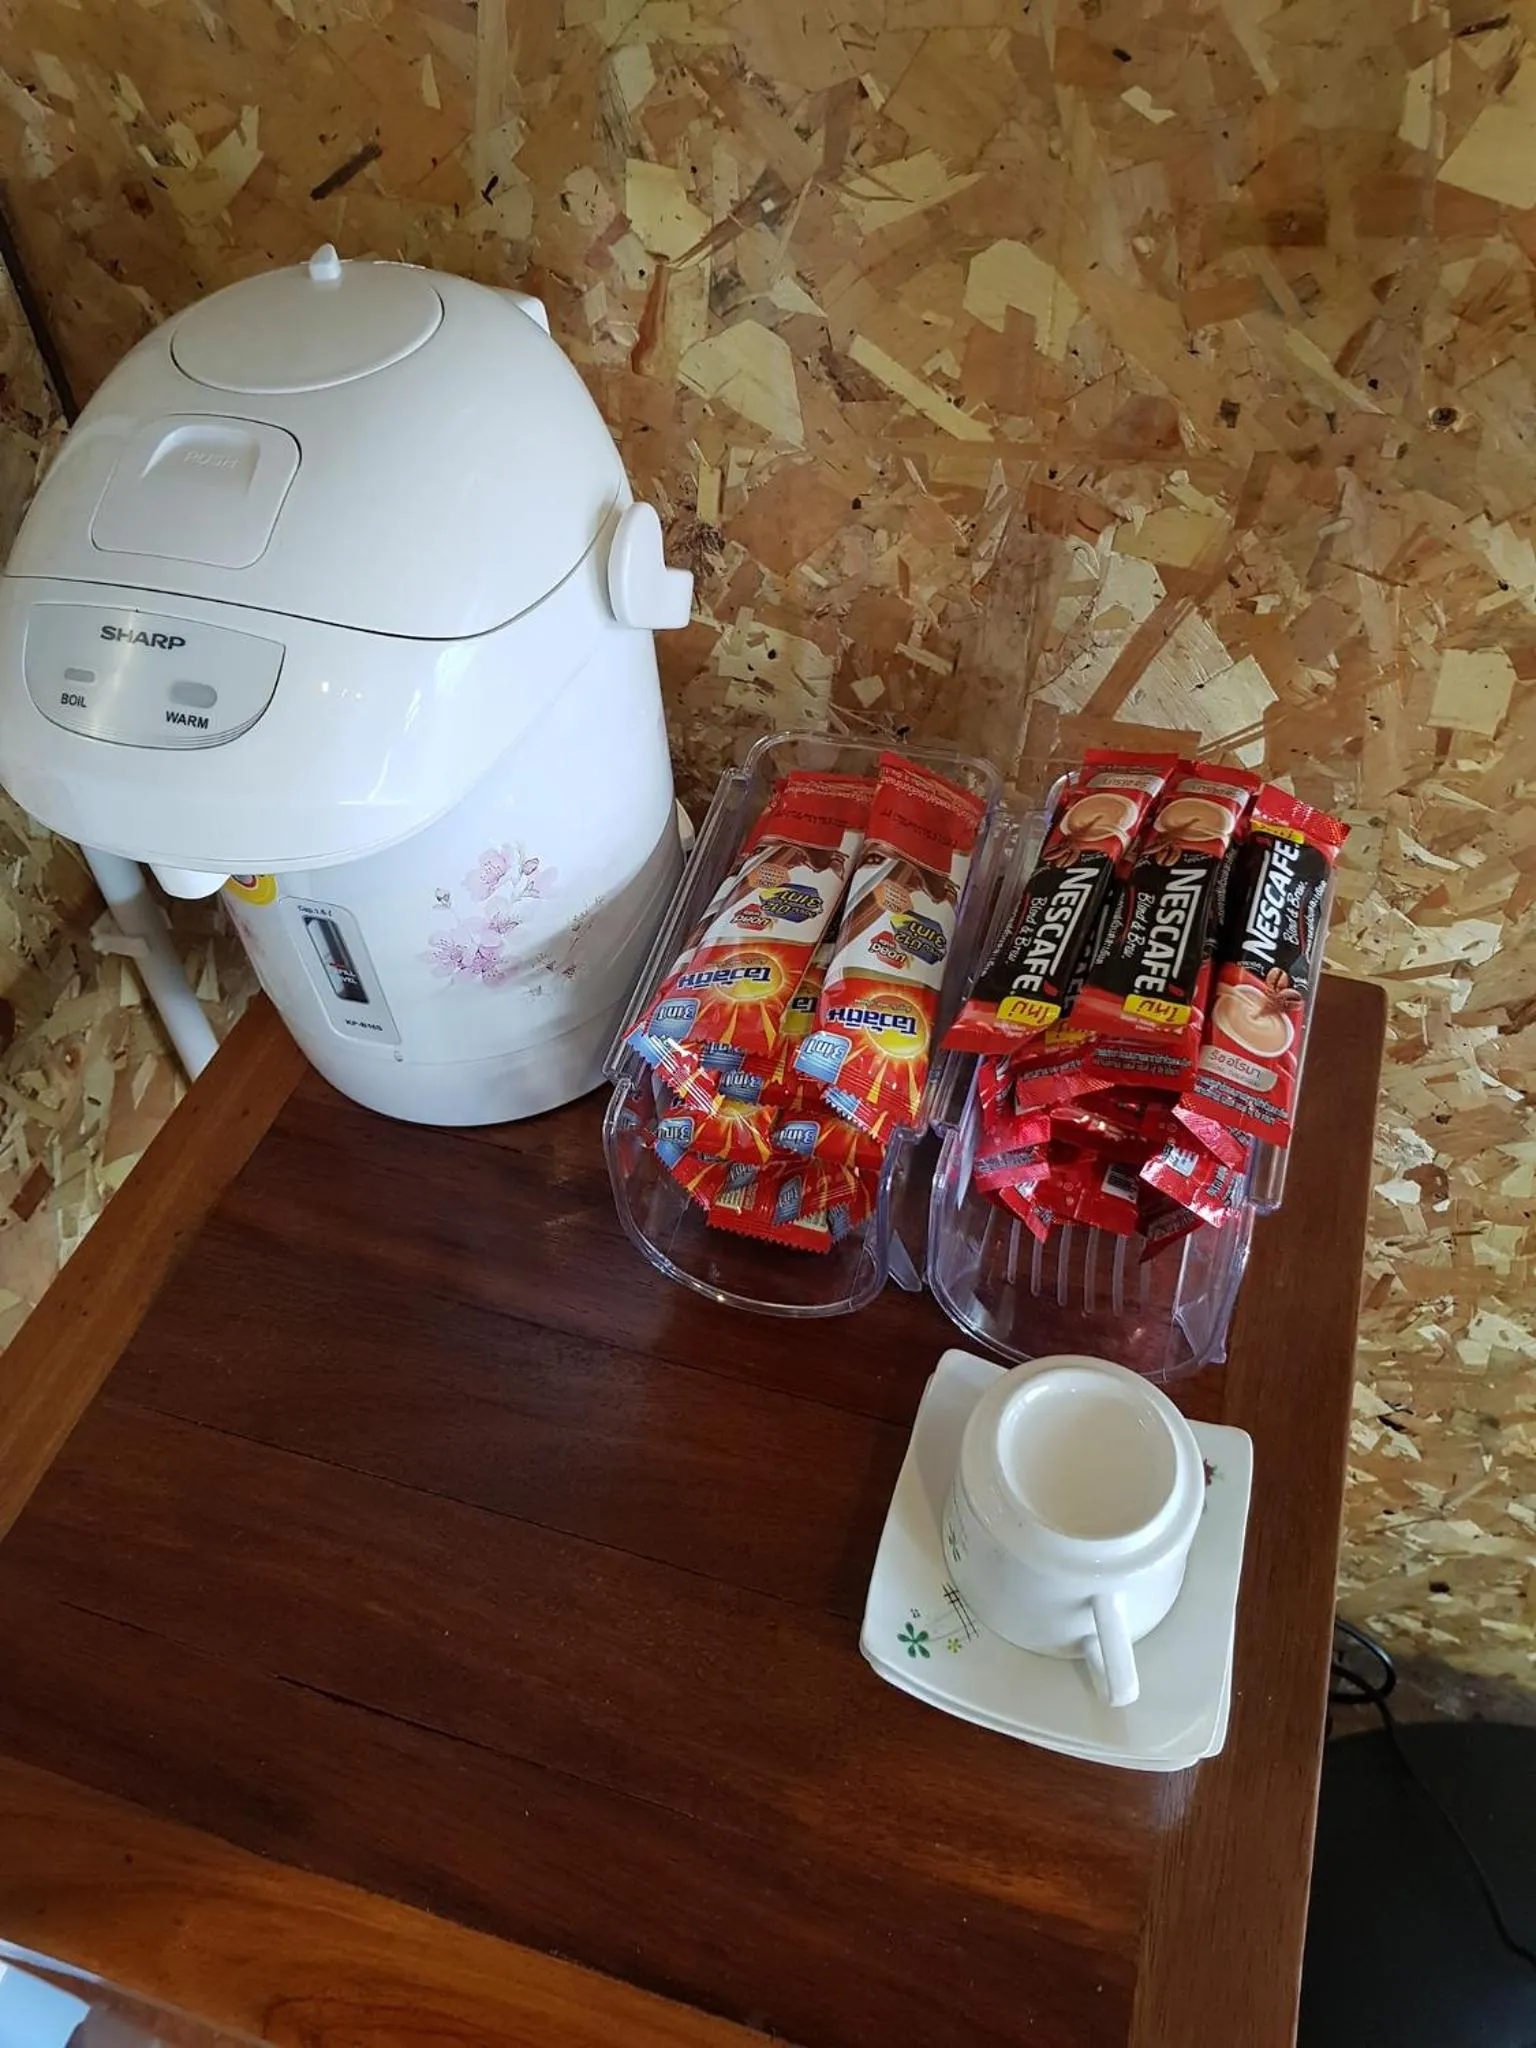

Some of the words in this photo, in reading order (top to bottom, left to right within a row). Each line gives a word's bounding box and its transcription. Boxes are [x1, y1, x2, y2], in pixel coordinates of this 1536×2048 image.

[100, 625, 186, 650] SHARP
[60, 693, 87, 708] BOIL
[165, 711, 209, 729] WARM
[677, 966, 771, 989] โอวัลติน
[827, 1007, 918, 1036] โอวัลติน
